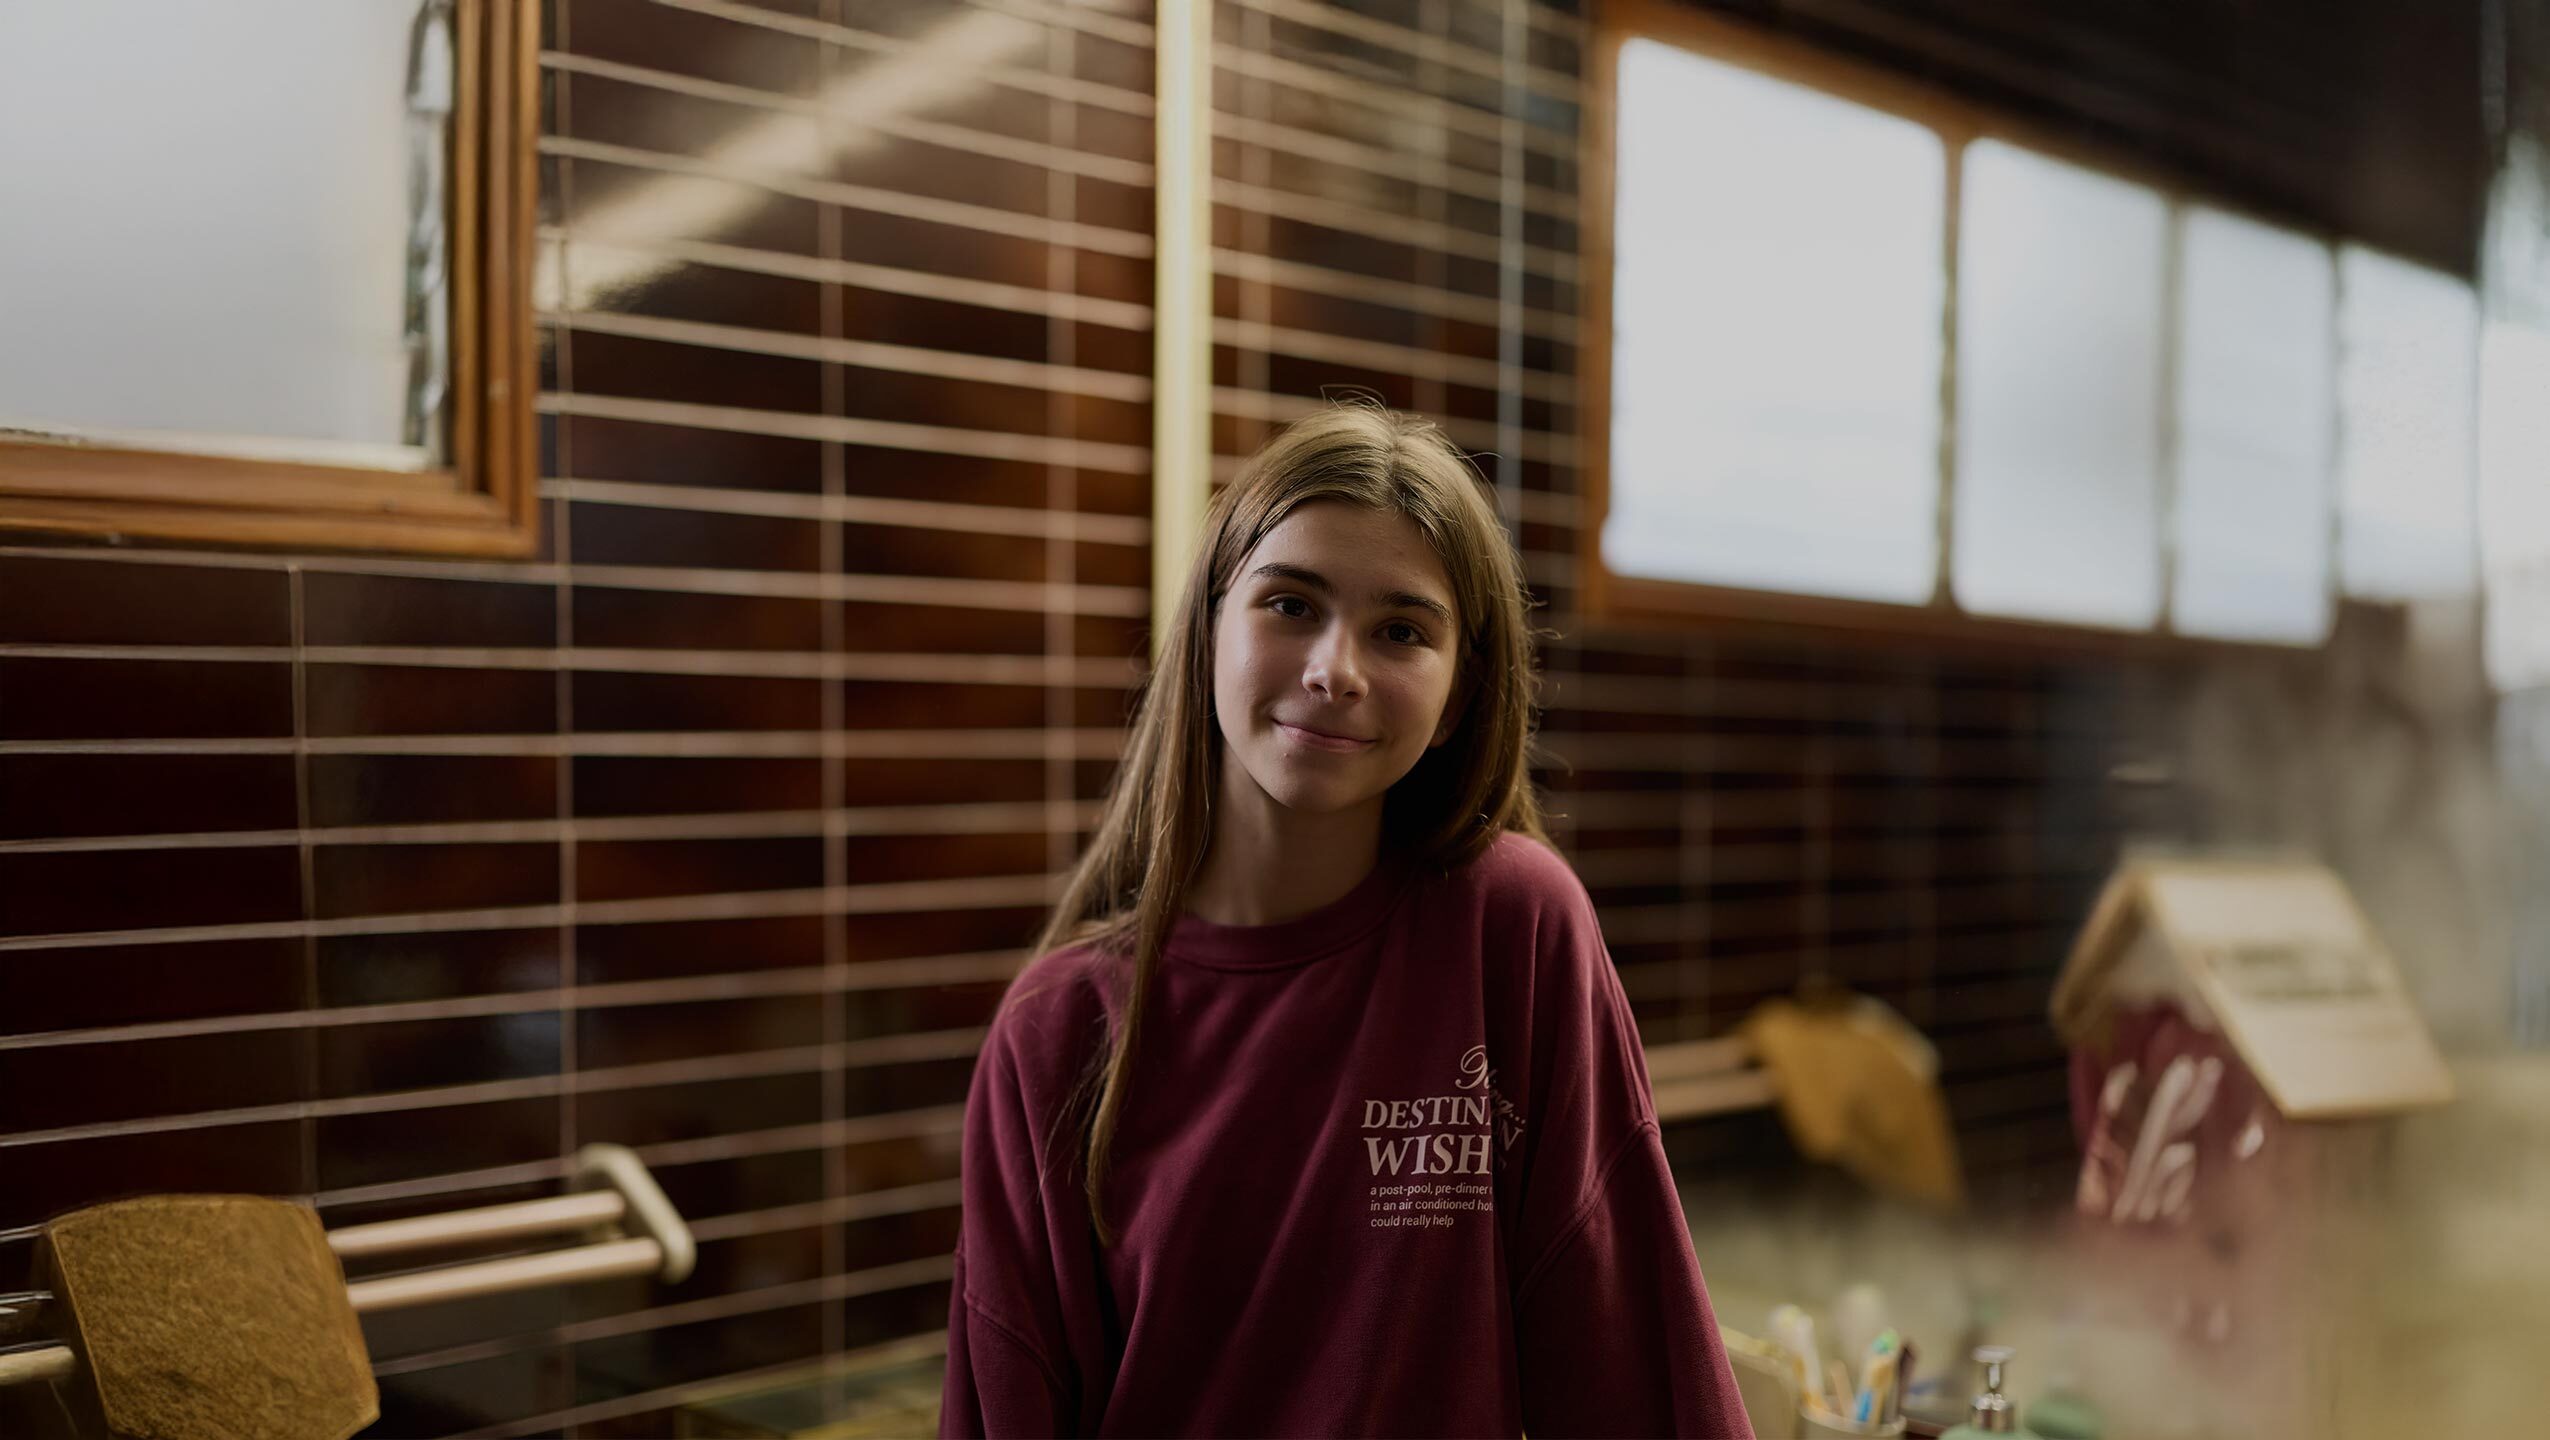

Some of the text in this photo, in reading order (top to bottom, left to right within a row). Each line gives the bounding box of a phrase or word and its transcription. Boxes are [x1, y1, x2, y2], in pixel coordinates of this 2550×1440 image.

[1370, 1187, 1377, 1195] a
[1379, 1183, 1433, 1197] post-pool,
[1435, 1182, 1488, 1196] pre-dinner
[1370, 1200, 1380, 1211] in
[1383, 1202, 1396, 1211] an
[1399, 1199, 1412, 1210] air
[1415, 1199, 1475, 1210] conditioned
[1370, 1215, 1454, 1228] could really help
